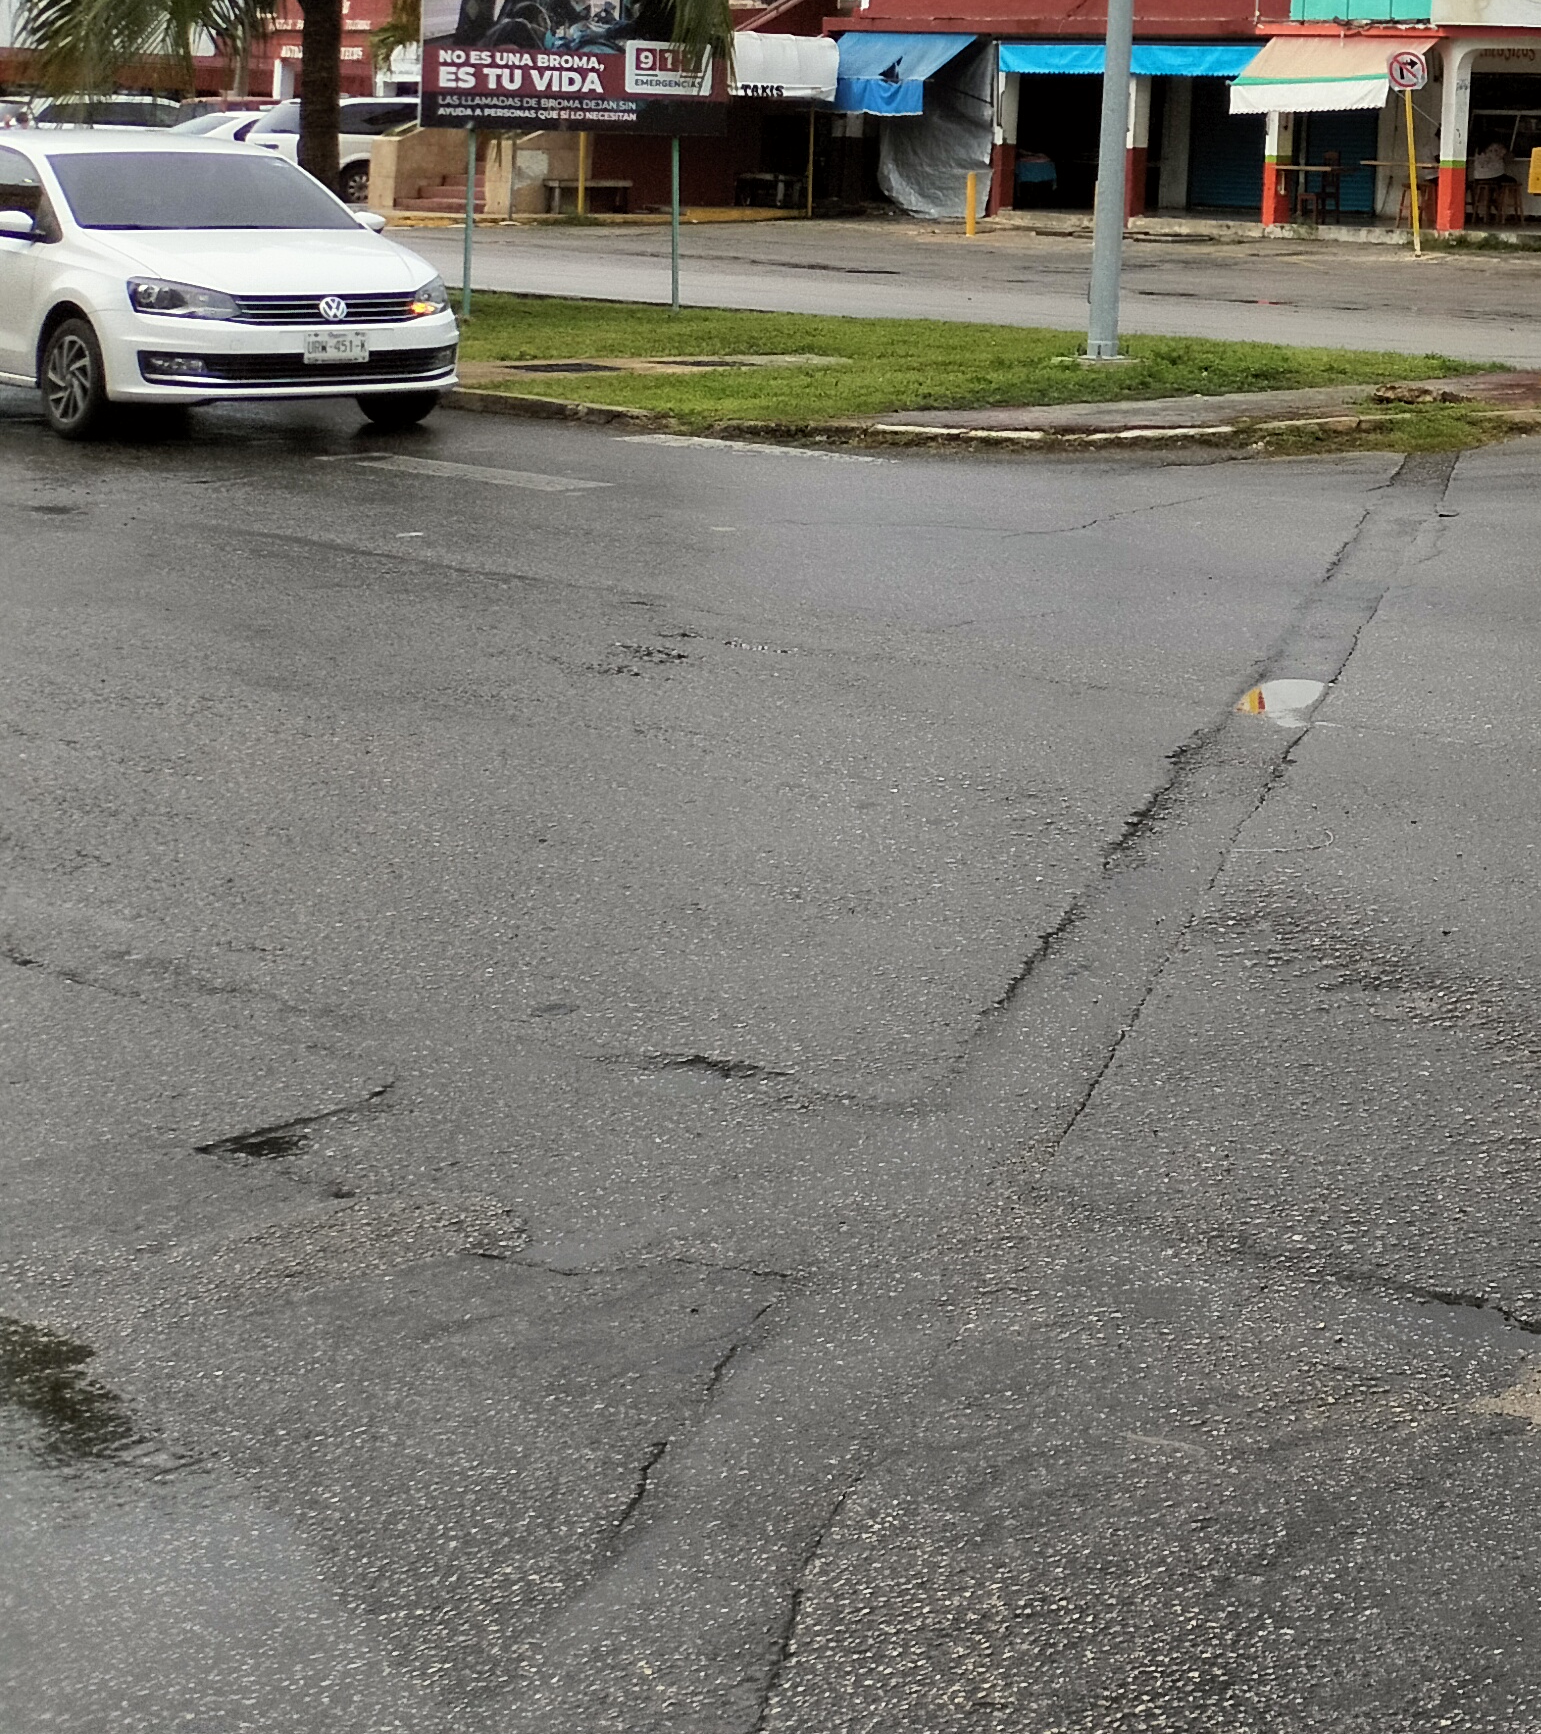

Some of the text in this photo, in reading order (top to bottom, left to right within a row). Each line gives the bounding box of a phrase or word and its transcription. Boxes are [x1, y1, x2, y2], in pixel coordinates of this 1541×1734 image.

[438, 49, 605, 72] NO ES UNA BROMA,
[438, 66, 604, 94] ES TU VIDA
[740, 83, 785, 98] TAXIS
[438, 95, 637, 110] LAS LLAMADAS DE BROMA DEJAN SIN
[438, 107, 473, 116] AYUDA
[474, 108, 483, 116] A
[484, 108, 537, 119] PERSONAS
[538, 110, 559, 120] QUE
[571, 111, 584, 120] LO
[585, 111, 637, 122] NECESITAN
